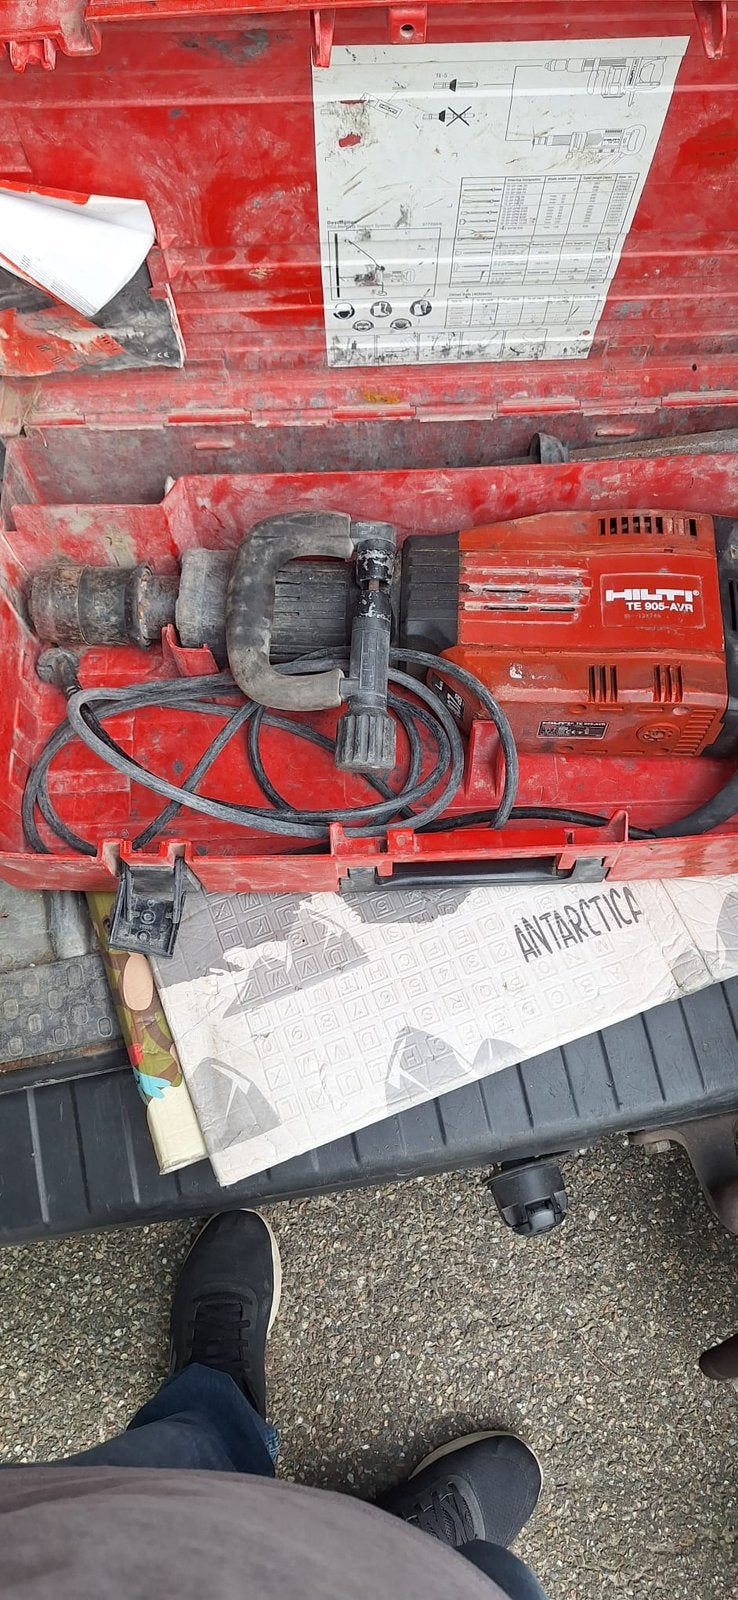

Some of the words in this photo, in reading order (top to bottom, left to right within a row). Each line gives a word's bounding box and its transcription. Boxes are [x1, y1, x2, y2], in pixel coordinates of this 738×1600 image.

[625, 602, 642, 611] TE
[644, 602, 694, 613] 905-AVR
[514, 886, 643, 963] ANTARCTICA
